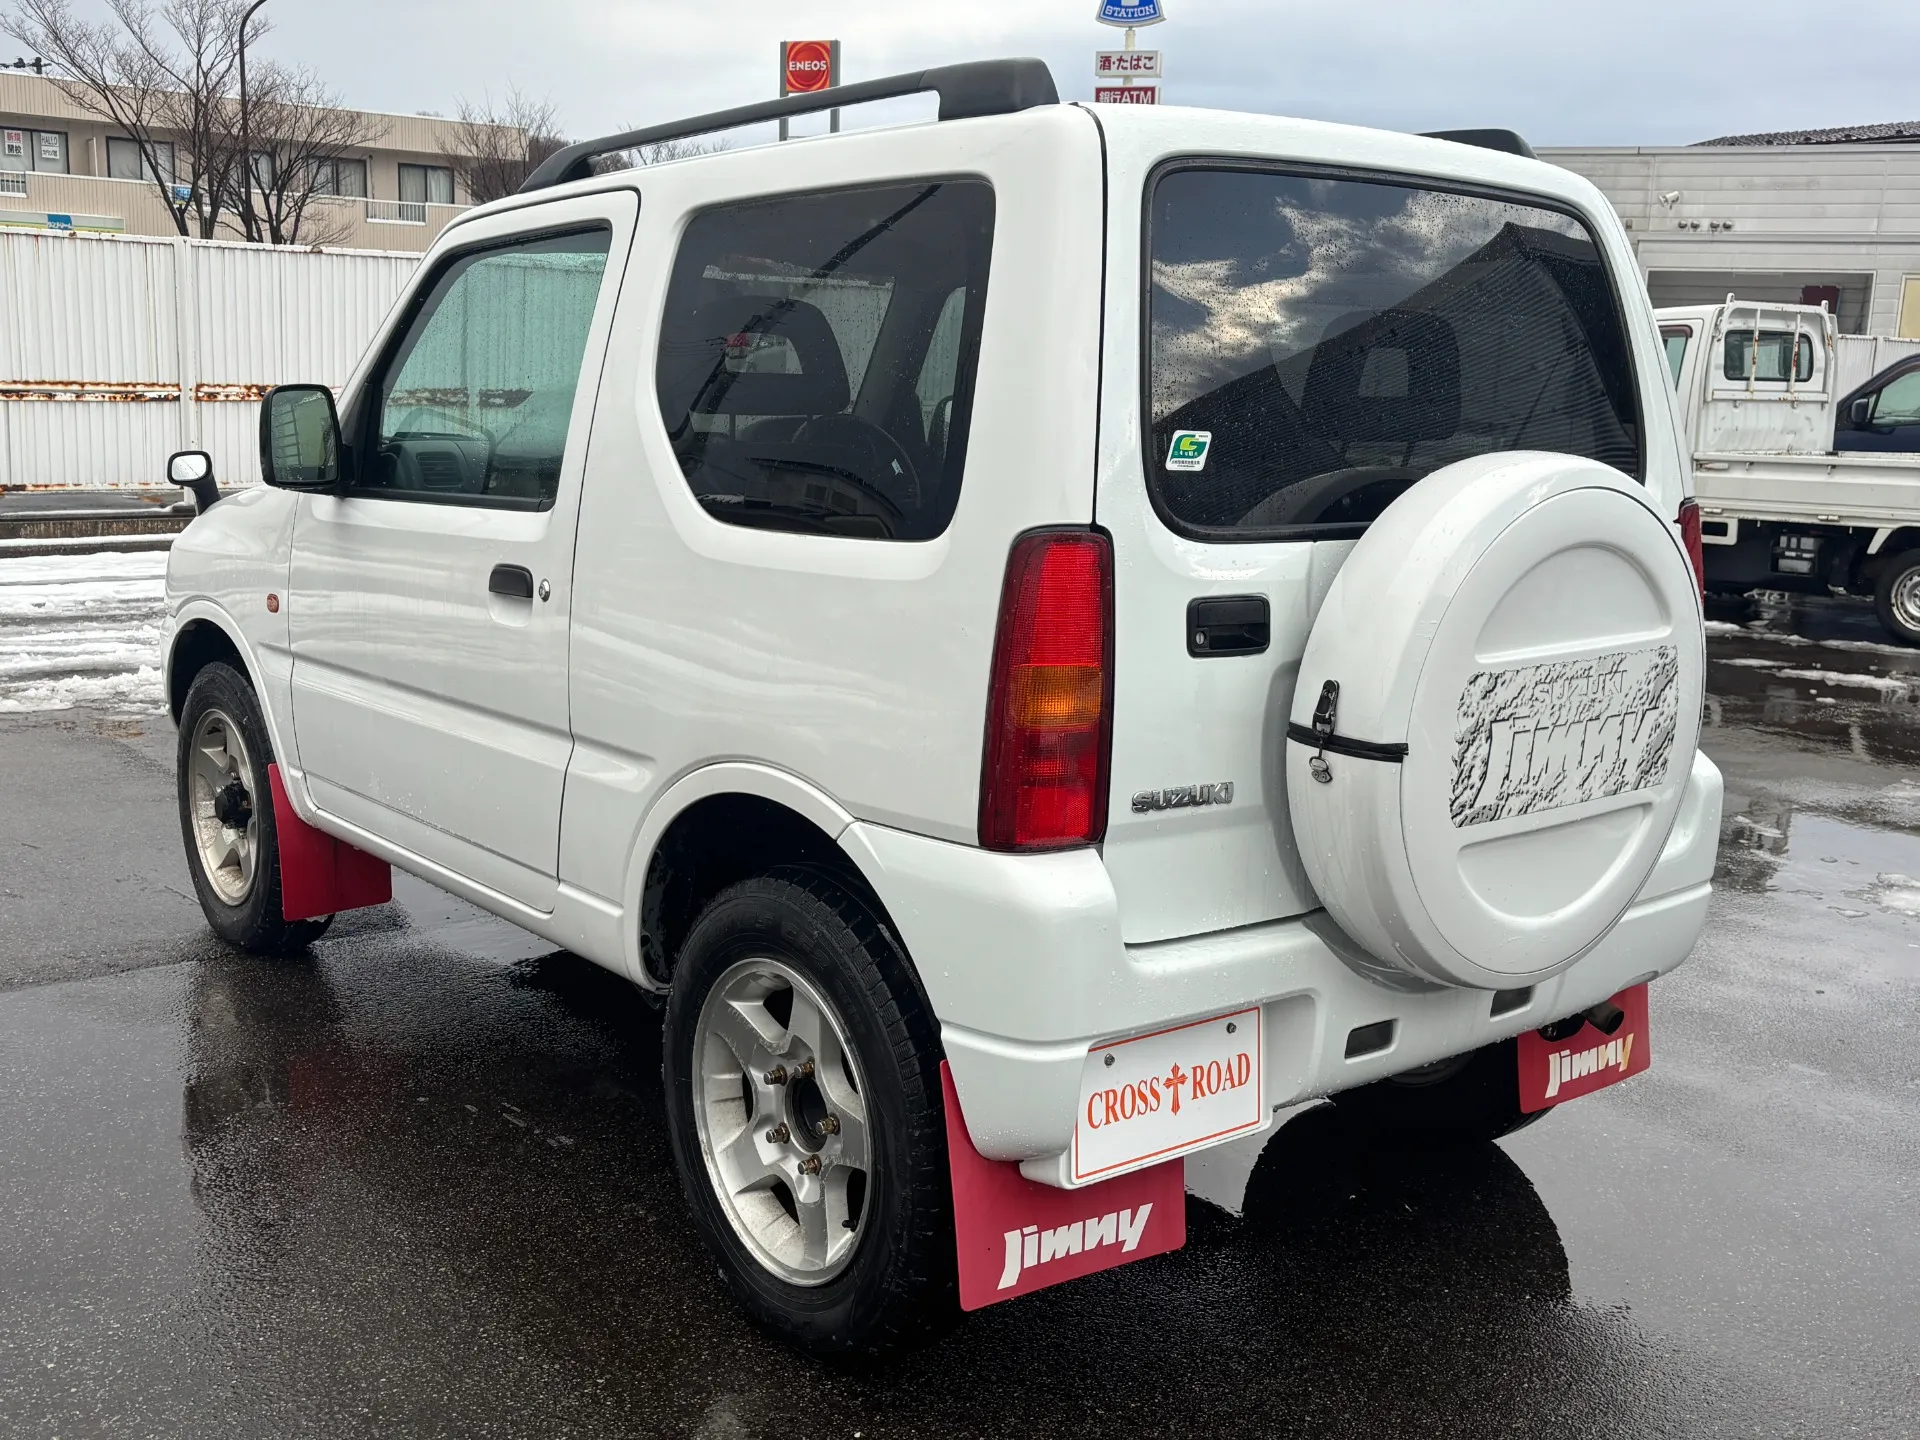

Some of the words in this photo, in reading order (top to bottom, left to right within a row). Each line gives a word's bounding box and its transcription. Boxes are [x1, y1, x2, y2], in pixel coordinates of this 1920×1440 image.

[1105, 4, 1154, 18] STATION
[789, 60, 827, 71] ENEOS
[1131, 781, 1234, 813] SUZUKI
[1087, 1076, 1161, 1129] CROSS
[1191, 1052, 1251, 1100] ROAD
